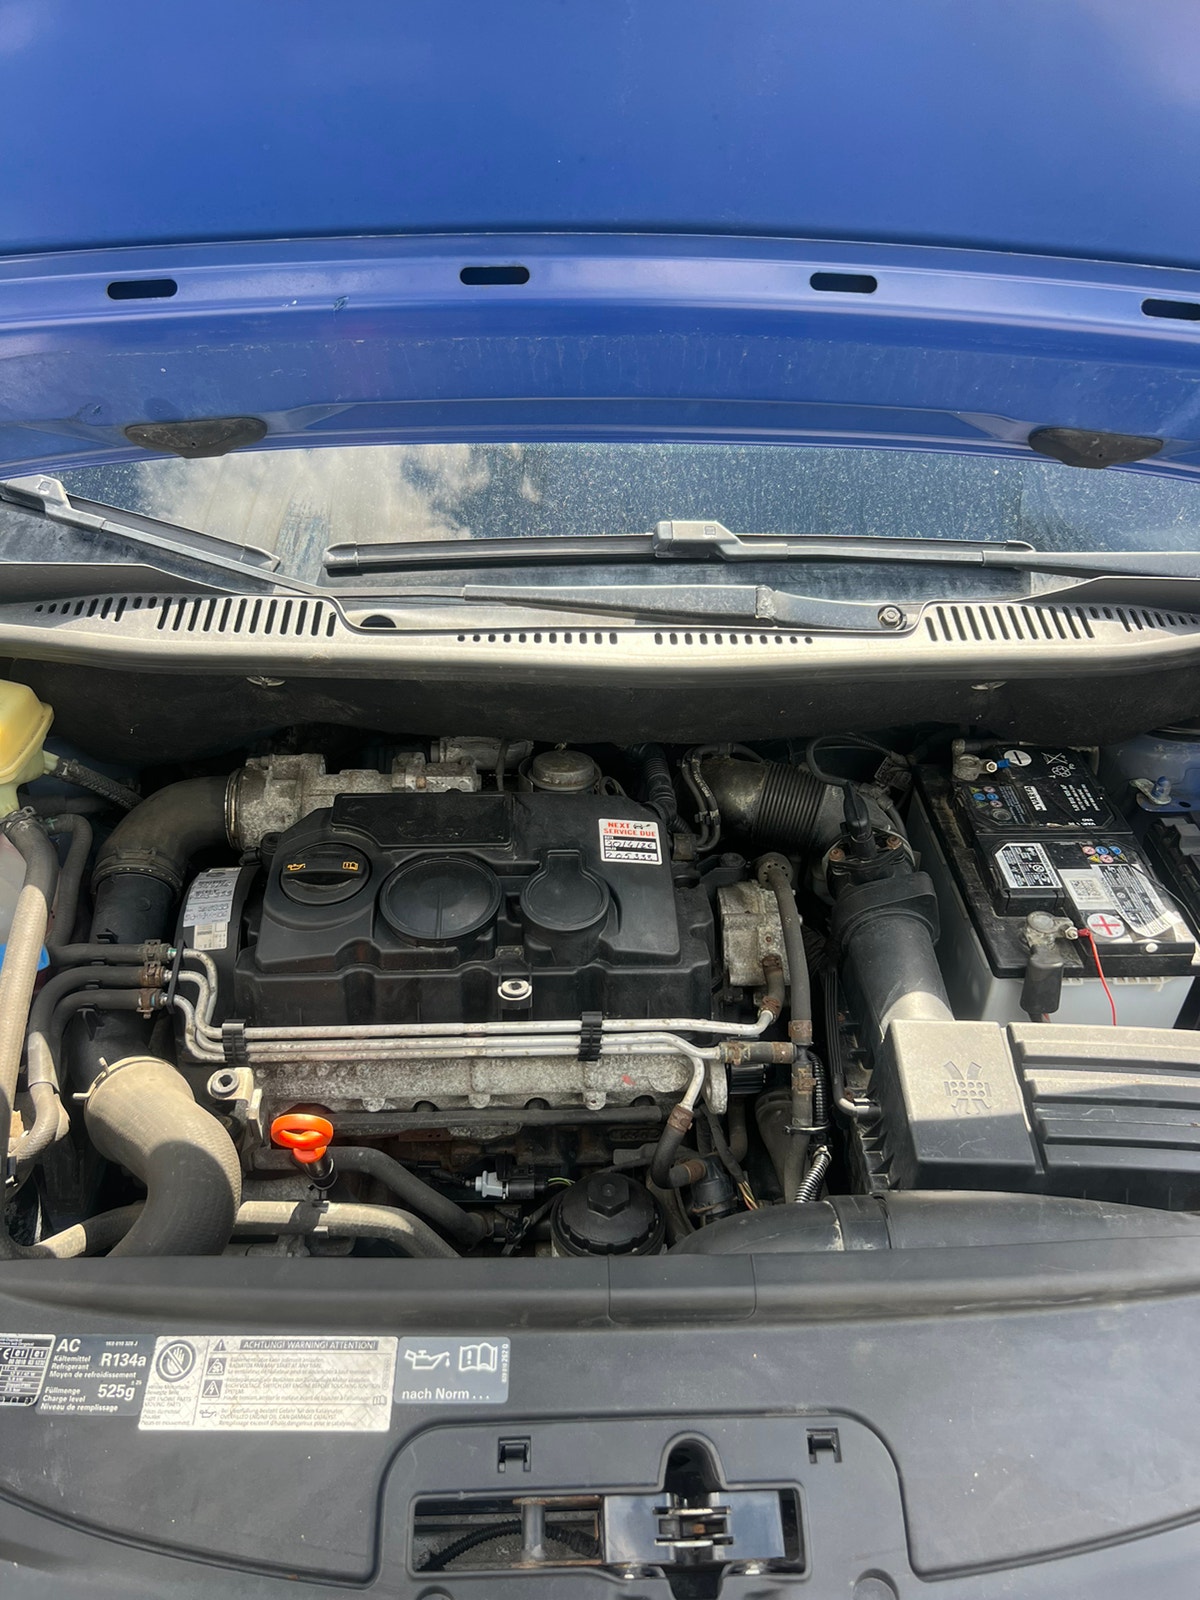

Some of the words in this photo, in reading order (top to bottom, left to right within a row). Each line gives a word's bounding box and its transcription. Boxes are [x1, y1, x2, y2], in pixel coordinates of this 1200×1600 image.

[607, 821, 630, 829] NEXT
[603, 828, 637, 836] SERVICE
[56, 1338, 81, 1353] AC
[243, 1340, 286, 1349] ACHTUNG!
[287, 1340, 329, 1349] WARNING!
[329, 1341, 376, 1349] ATTENTION!
[100, 1352, 147, 1367] R134a
[51, 1362, 90, 1371] Refrigerant
[49, 1370, 72, 1379] Moyen
[84, 1371, 137, 1379] refroidissement
[44, 1385, 81, 1396] Füllmenge
[97, 1383, 135, 1401] 525g
[401, 1387, 432, 1400] nach
[435, 1387, 470, 1400] Norm
[42, 1395, 67, 1403] Charge
[40, 1402, 65, 1411] Niveau
[66, 1403, 75, 1411] de
[76, 1403, 118, 1413] remplissage
